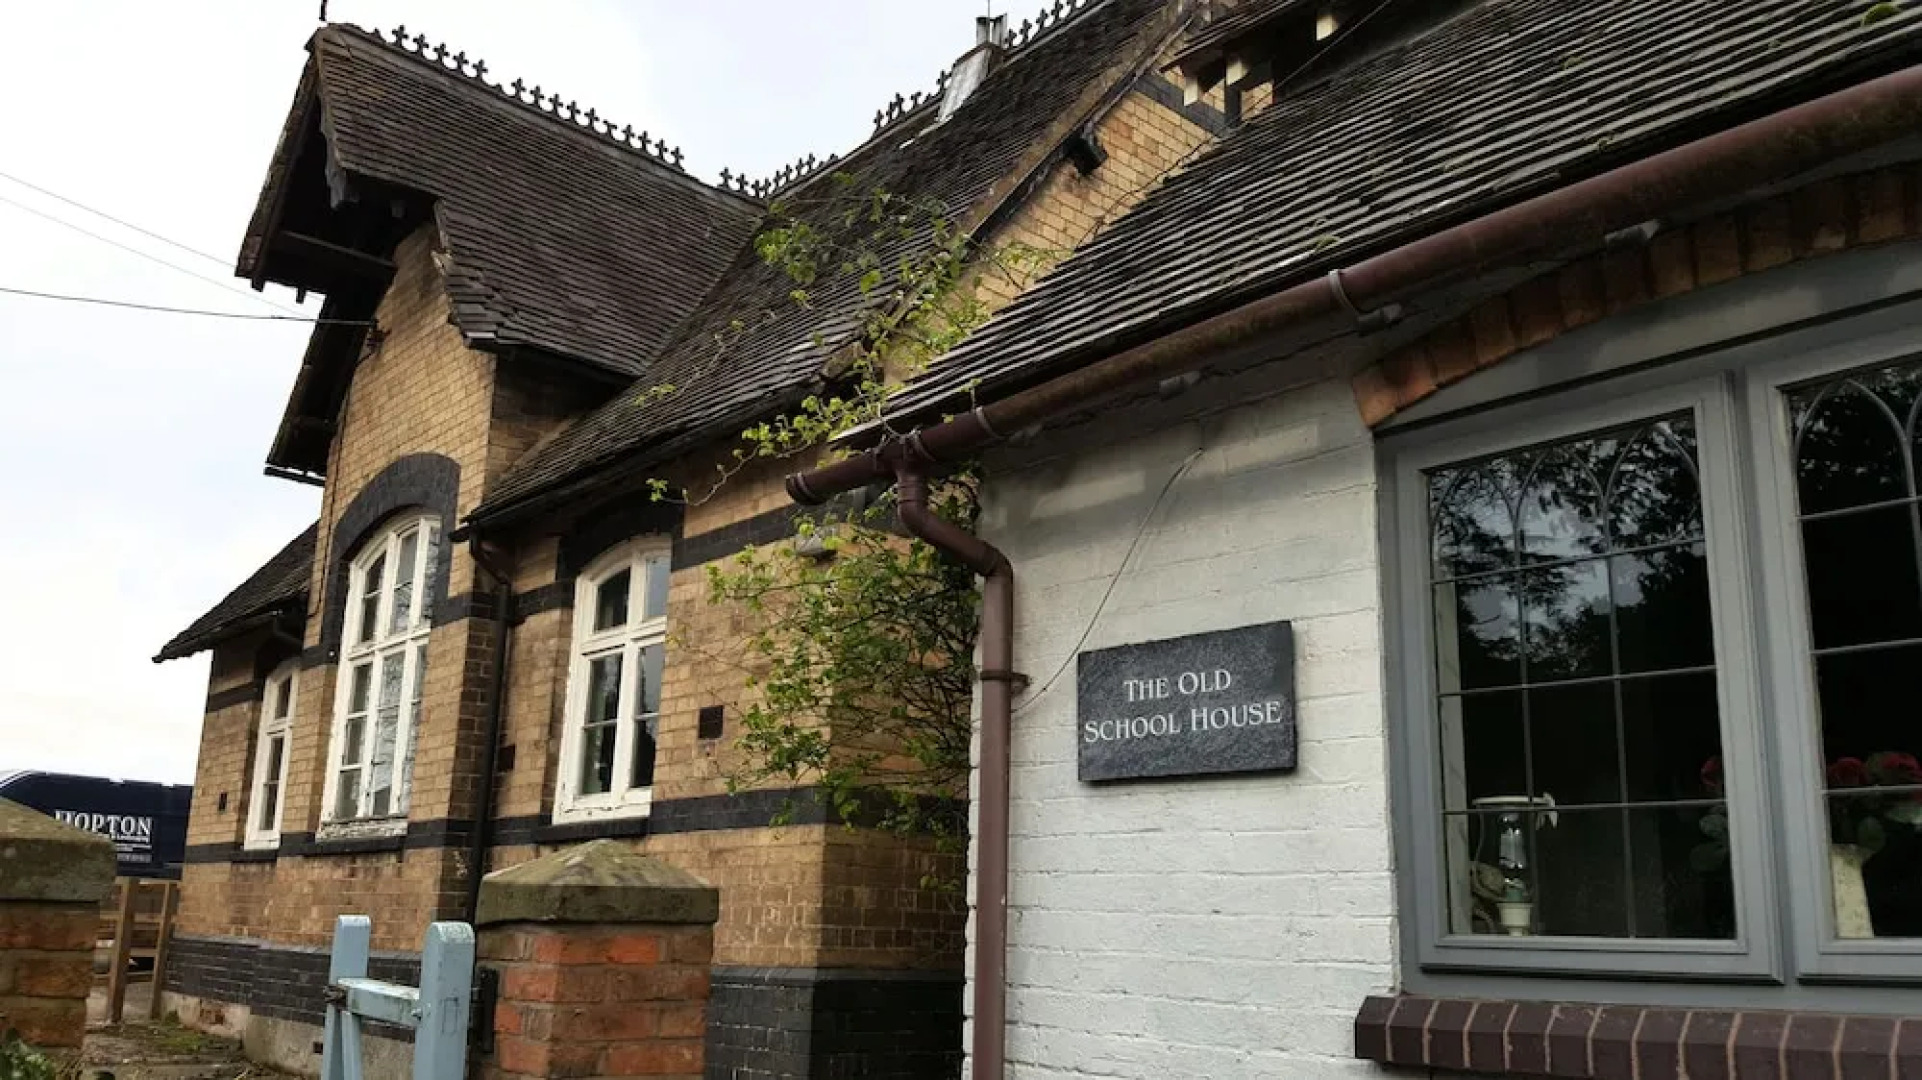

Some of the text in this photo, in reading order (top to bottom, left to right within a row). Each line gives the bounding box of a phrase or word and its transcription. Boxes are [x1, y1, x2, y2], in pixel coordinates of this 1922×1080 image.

[1124, 669, 1231, 702] THE OLD
[1084, 701, 1281, 743] SCHOOL HOUSE
